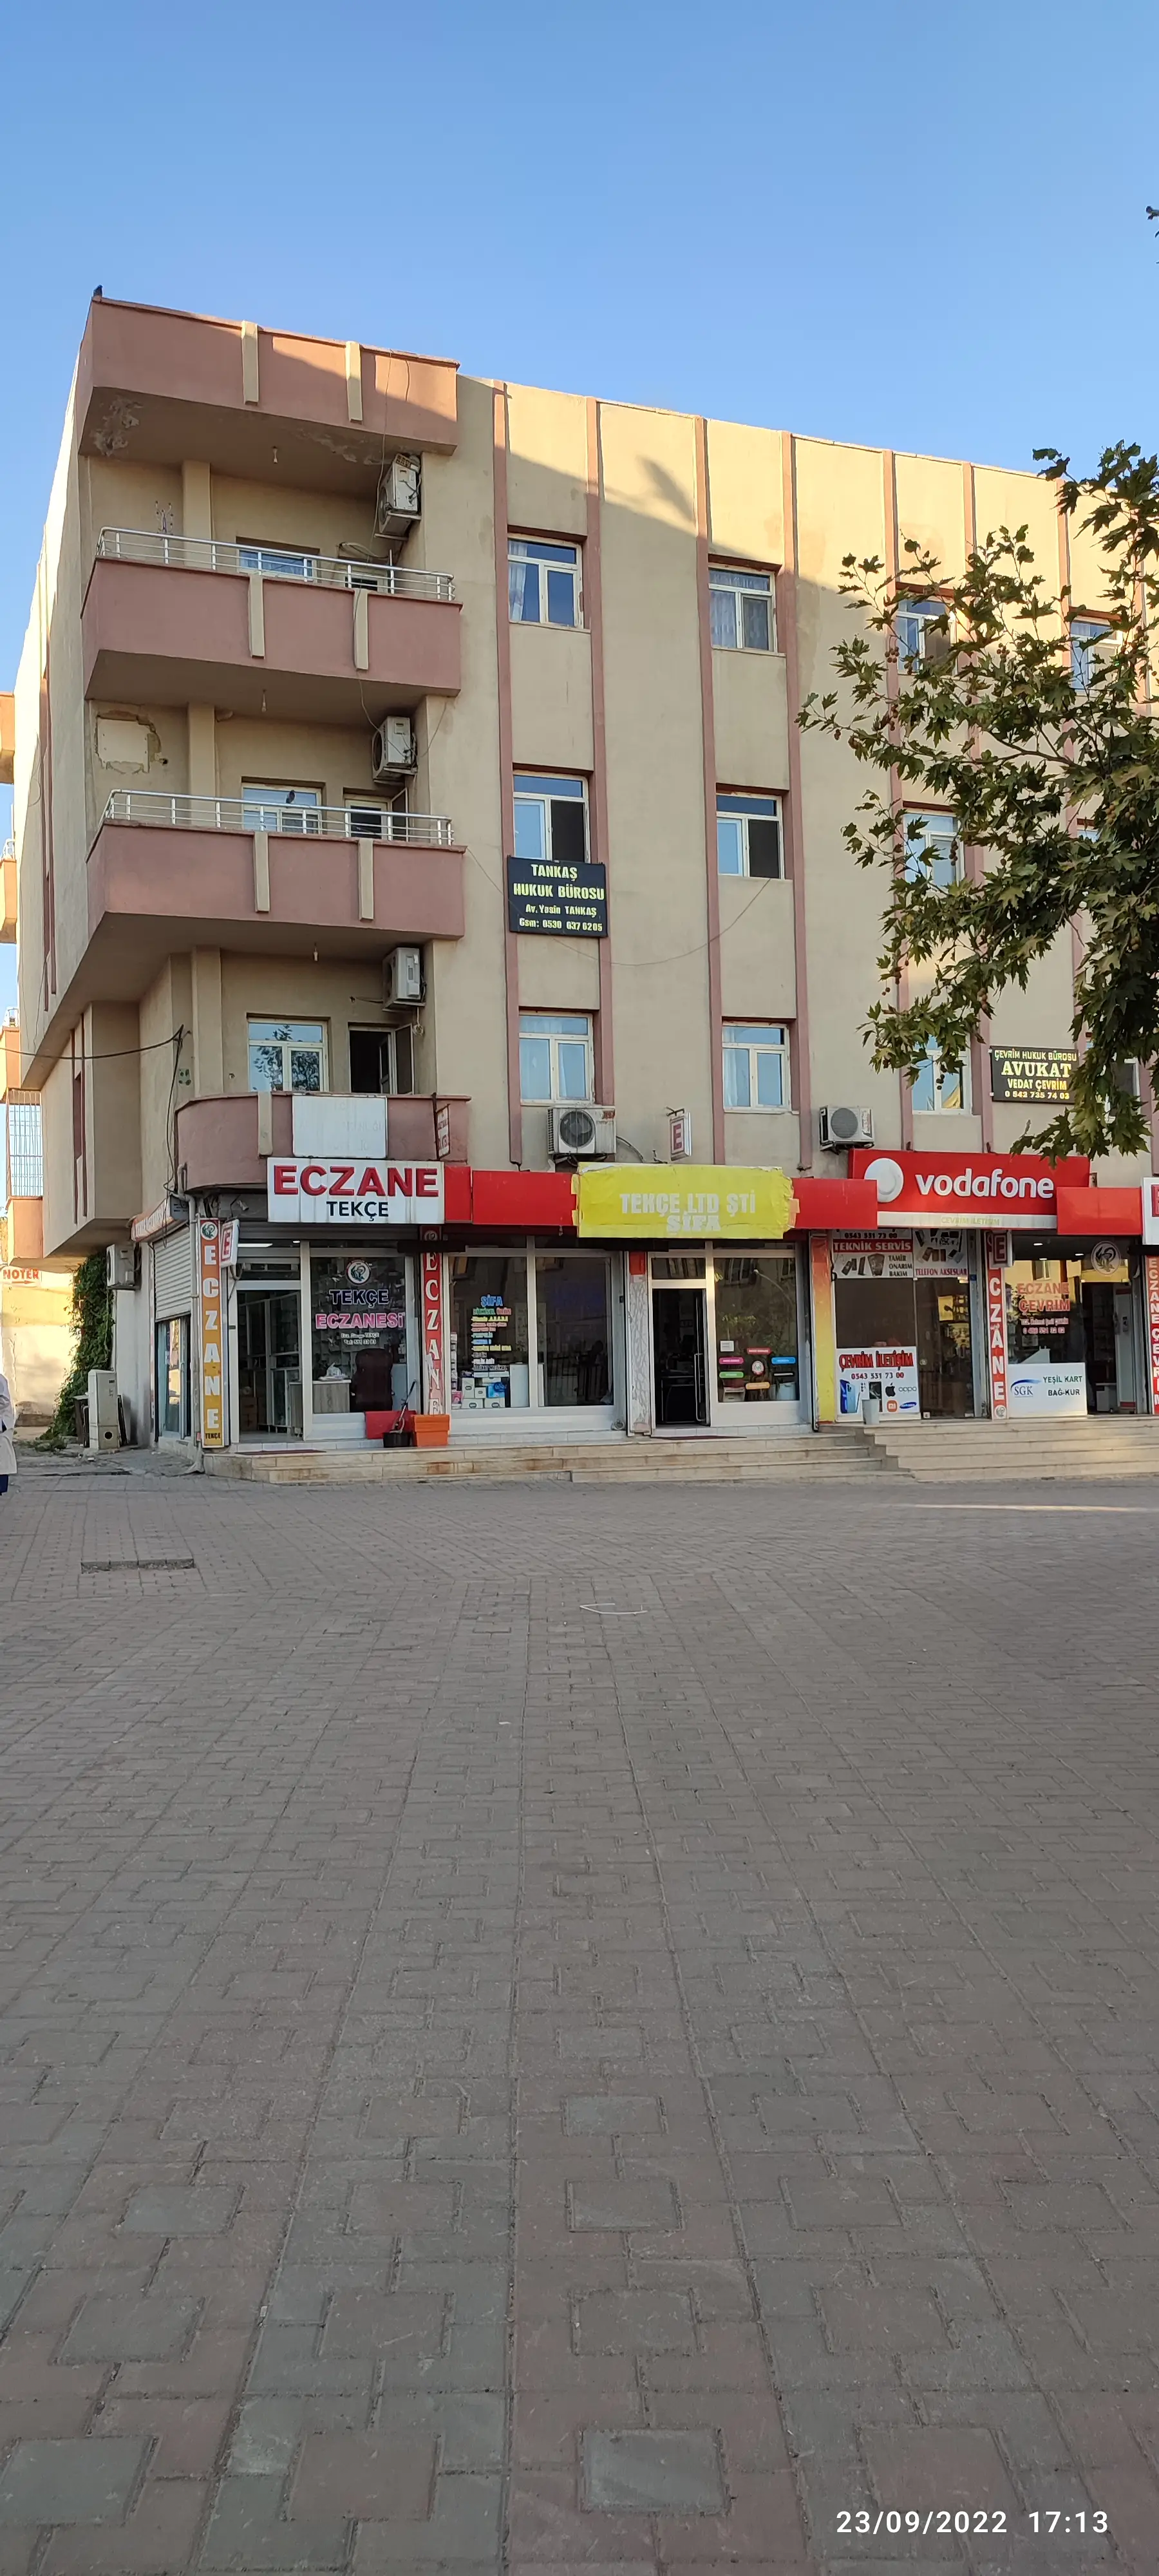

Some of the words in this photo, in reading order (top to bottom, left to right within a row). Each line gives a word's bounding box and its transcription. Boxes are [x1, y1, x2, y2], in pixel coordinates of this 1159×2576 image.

[531, 864, 578, 882] TANKAŞ
[513, 883, 553, 898] HUKUK
[558, 884, 605, 900] BÜROSU
[525, 904, 538, 913] Av.
[539, 904, 561, 914] Yasin
[565, 905, 597, 918] TANKAŞ
[994, 1048, 1021, 1061] ÇEVRİM
[1022, 1050, 1046, 1061] HUKUK
[1048, 1050, 1077, 1061] BÜROSU
[1001, 1061, 1072, 1078] AVUKAT
[1007, 1078, 1033, 1089] VEDAT
[1035, 1078, 1067, 1092] ÇEVRİM
[674, 1123, 683, 1150] E
[274, 1164, 439, 1197] ECZANE
[915, 1168, 1054, 1198] vodafone
[326, 1201, 388, 1222] TEKÇE
[619, 1193, 680, 1217] TEKÇE
[688, 1193, 719, 1213] LTD
[726, 1189, 755, 1217] ŞTİ
[666, 1211, 721, 1235] ŞİFA
[833, 1240, 872, 1251] TEKNİK
[875, 1240, 911, 1251] SERVİS
[3, 1268, 40, 1280] NOTER
[1017, 1282, 1069, 1294] ECZANE
[328, 1289, 389, 1308] TEKÇE
[316, 1312, 405, 1329] ECZANESİ
[202, 1245, 221, 1429] ECZANE
[839, 1350, 874, 1372] ÇEVRİM
[876, 1349, 914, 1370] İLETİŞİM
[1042, 1374, 1062, 1384] YEŞİL
[1013, 1385, 1033, 1396] SGK
